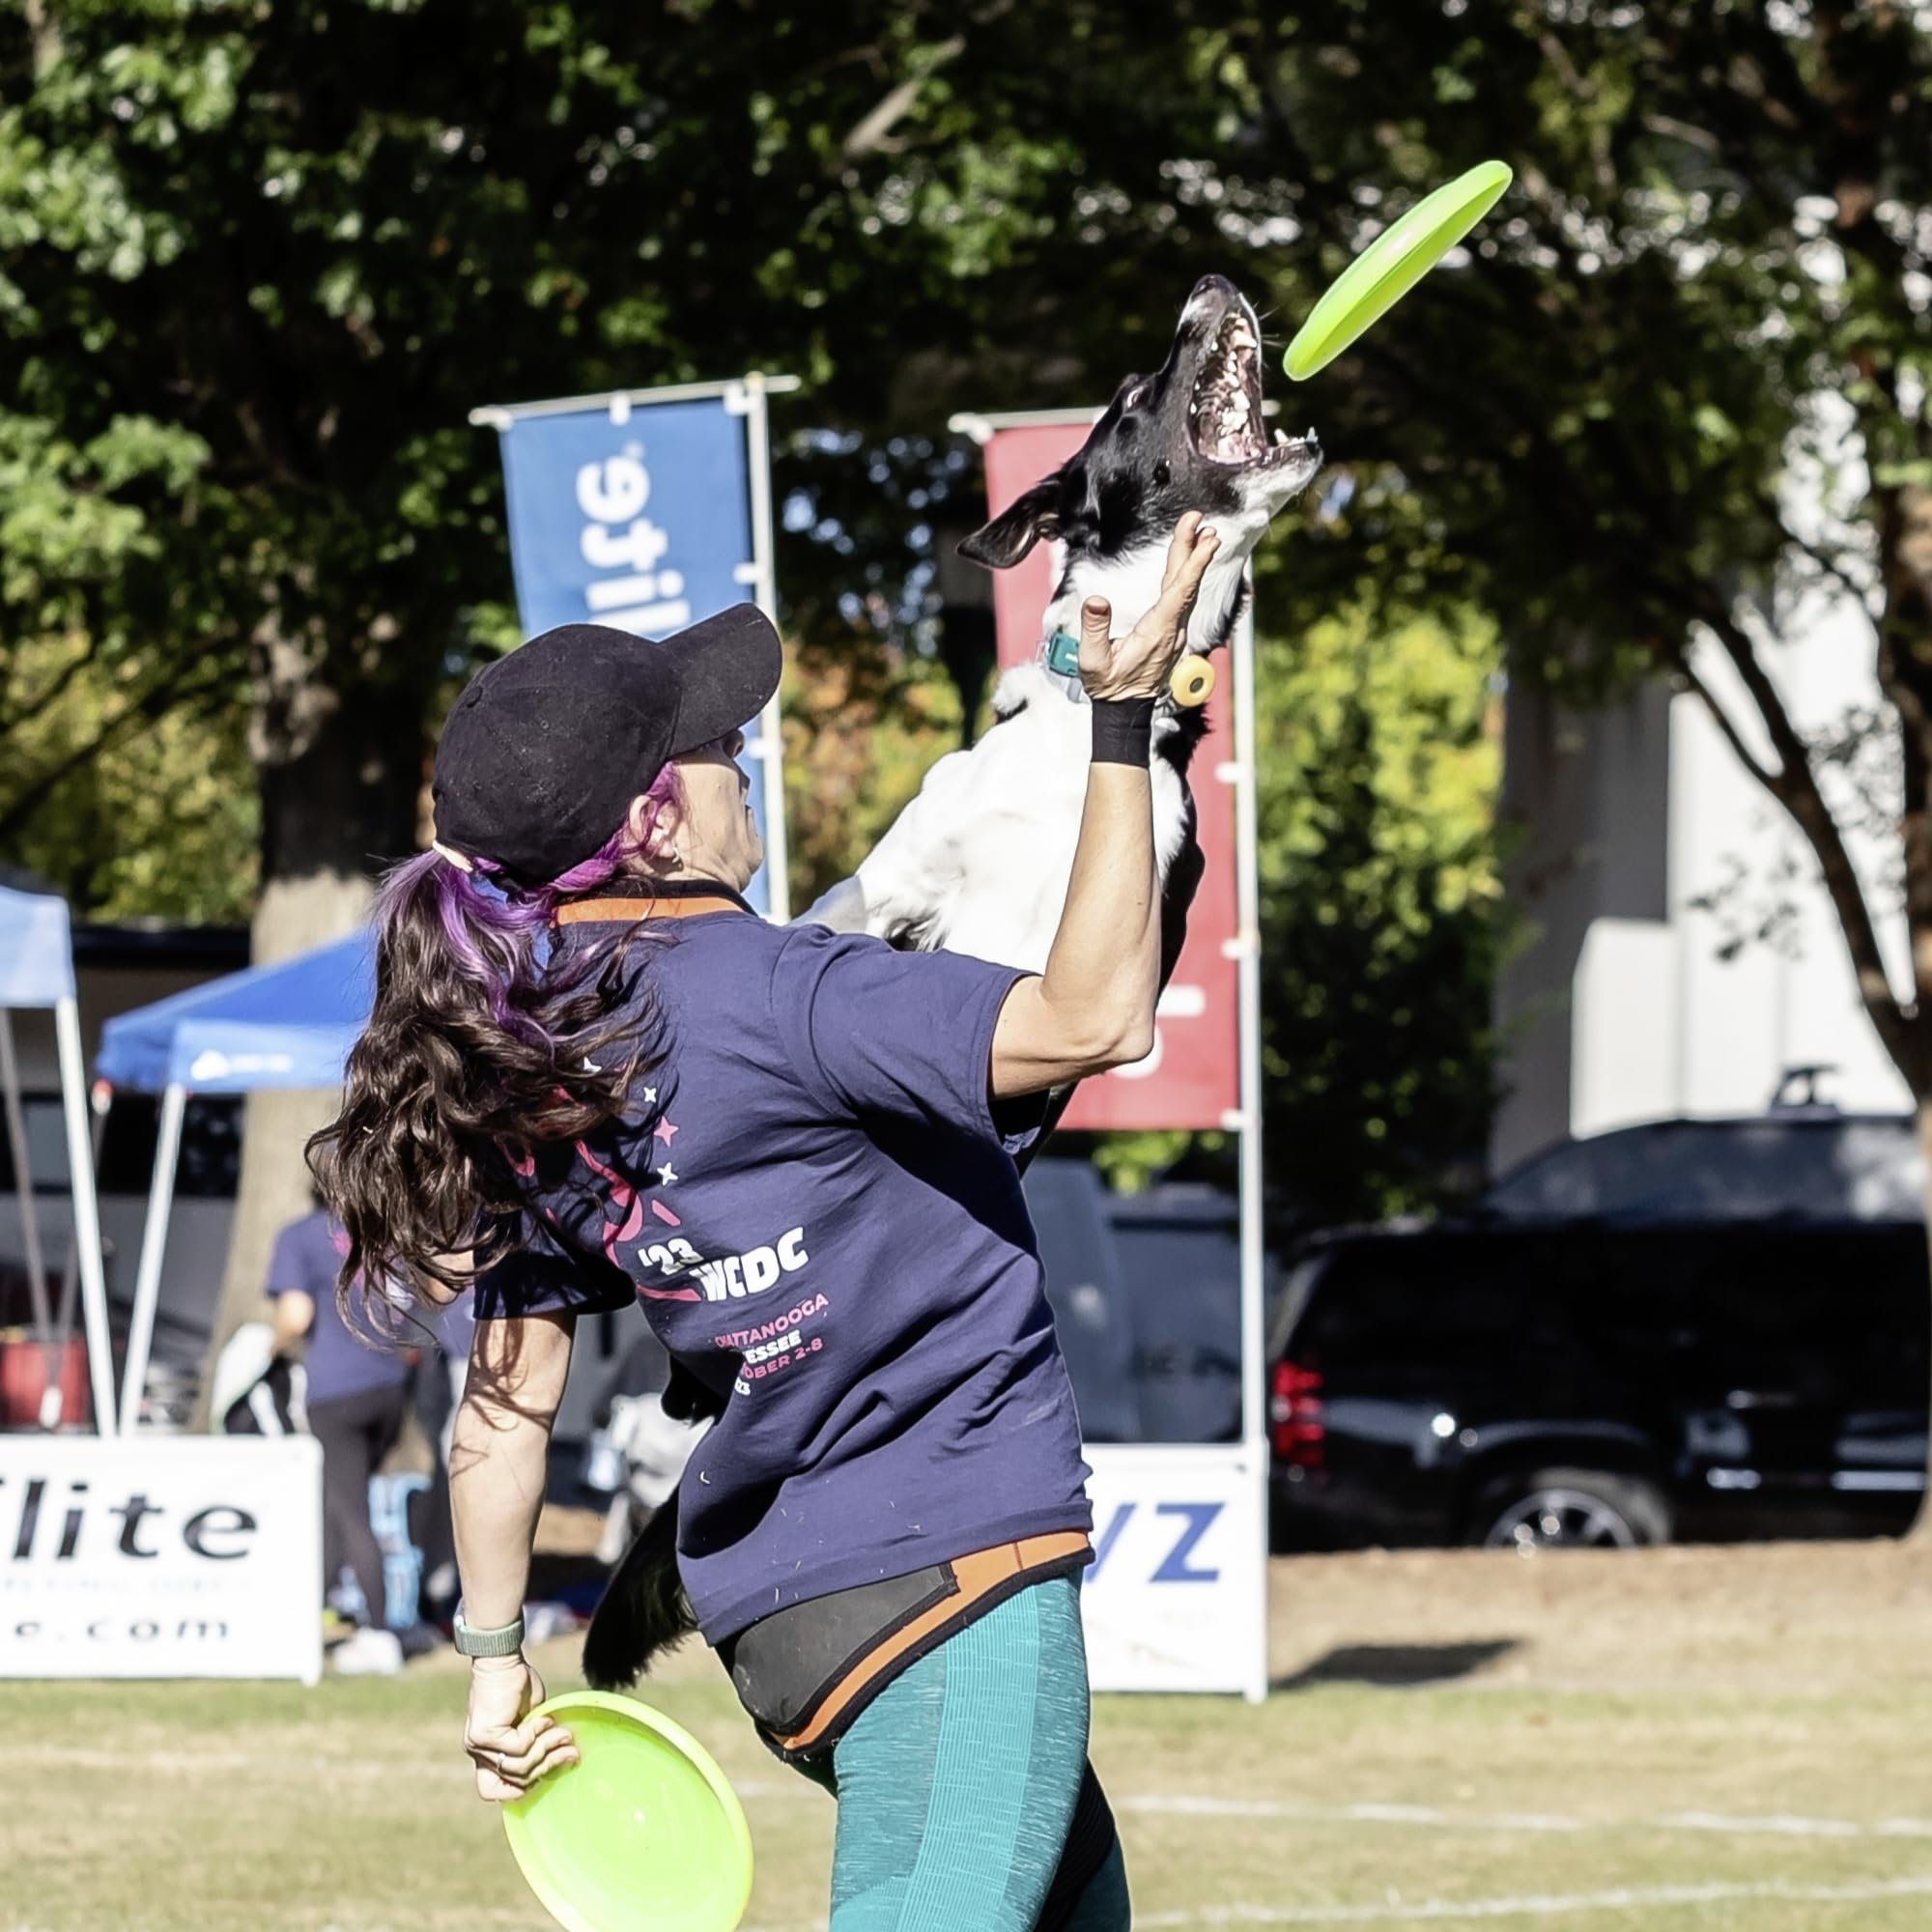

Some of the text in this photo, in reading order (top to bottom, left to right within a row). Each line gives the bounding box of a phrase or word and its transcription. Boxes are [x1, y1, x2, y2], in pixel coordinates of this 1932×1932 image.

[688, 1226, 810, 1302] WCDC
[741, 1329, 803, 1365] ESSEE
[794, 1337, 824, 1361] 2-8
[0, 1479, 258, 1560] lite
